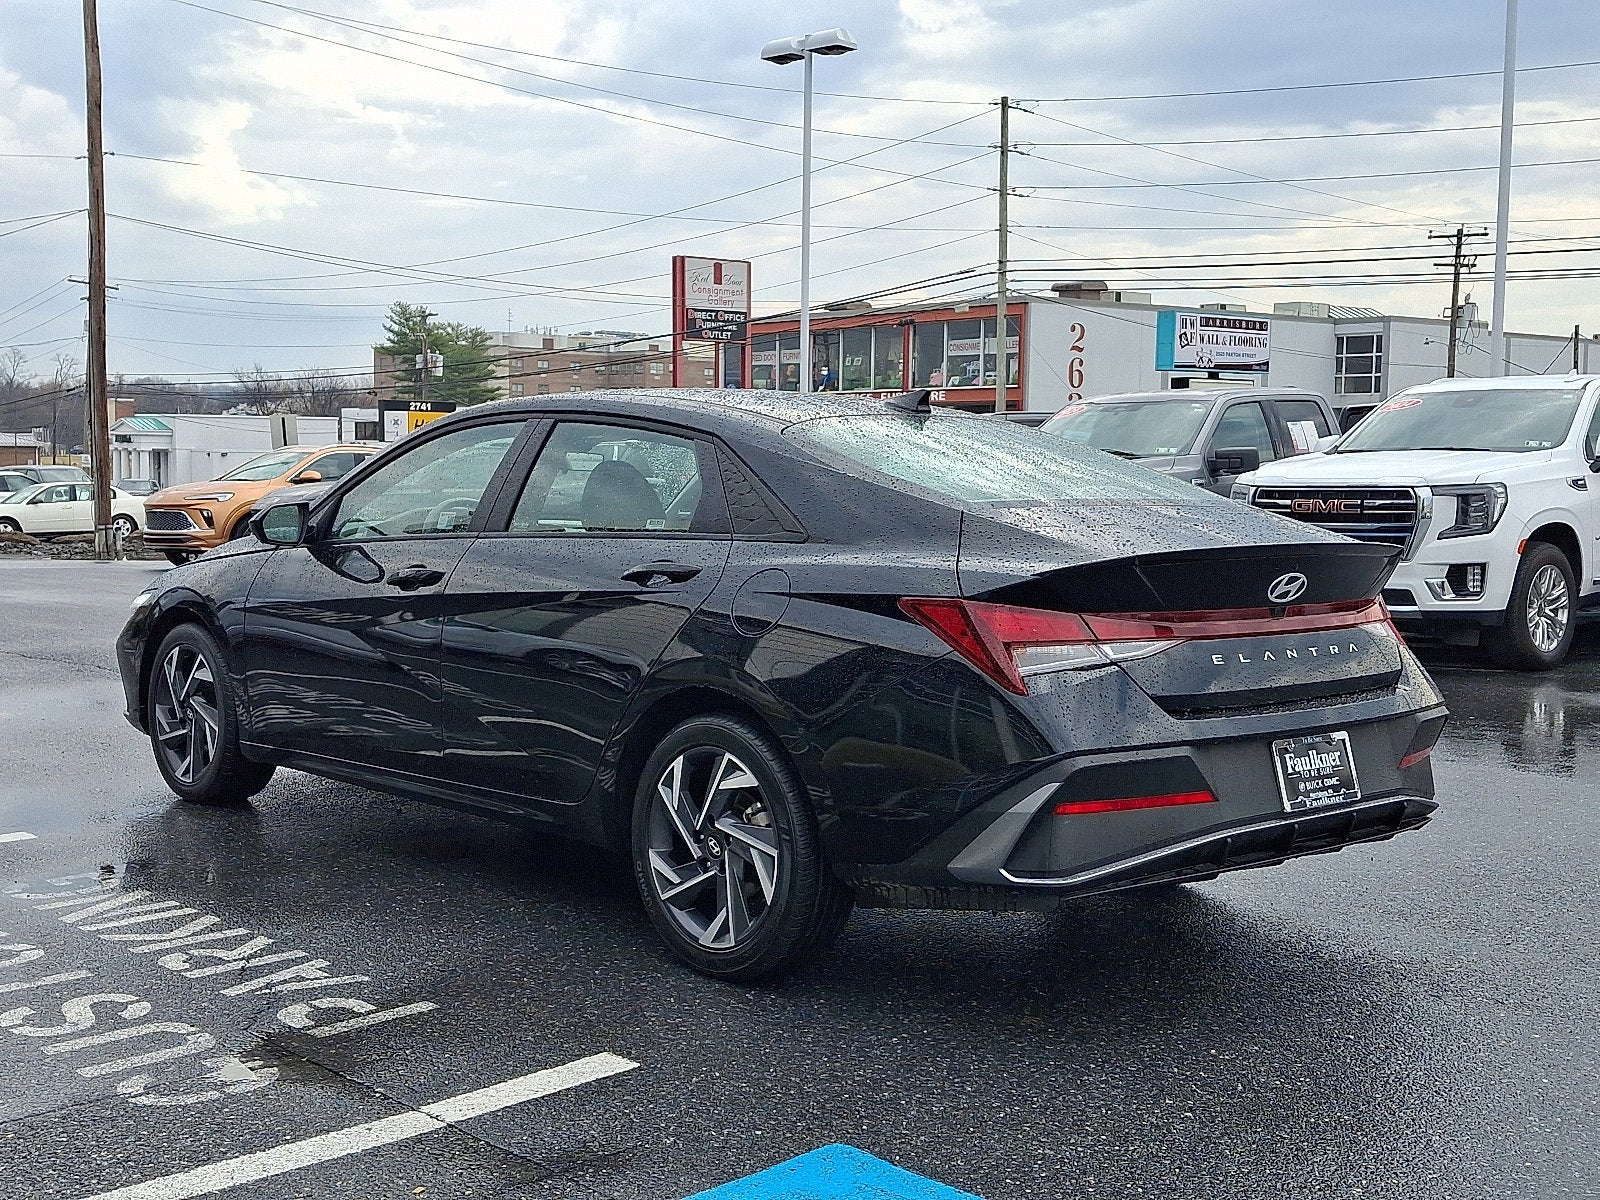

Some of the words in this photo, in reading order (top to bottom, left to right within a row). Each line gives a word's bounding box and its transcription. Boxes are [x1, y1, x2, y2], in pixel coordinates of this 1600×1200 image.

[723, 273, 744, 286] Door
[691, 282, 745, 298] Consignment
[707, 294, 735, 309] Gallery
[688, 309, 717, 319] DIRECT
[717, 311, 746, 321] OFFICE
[1201, 317, 1268, 330] HARRISBURG
[702, 329, 732, 340] OUTLET
[1199, 333, 1220, 346] WALL
[1221, 335, 1227, 346] &
[1228, 335, 1268, 349] FLOORING
[1067, 322, 1085, 401] 26
[409, 402, 432, 411] 2741
[1291, 498, 1361, 514] GMC
[1211, 642, 1359, 665] ELANTRA
[1283, 749, 1341, 774] Faulkner
[1299, 770, 1310, 779] TO
[1306, 780, 1323, 790] BUICK
[1305, 794, 1344, 808] Faulkner
